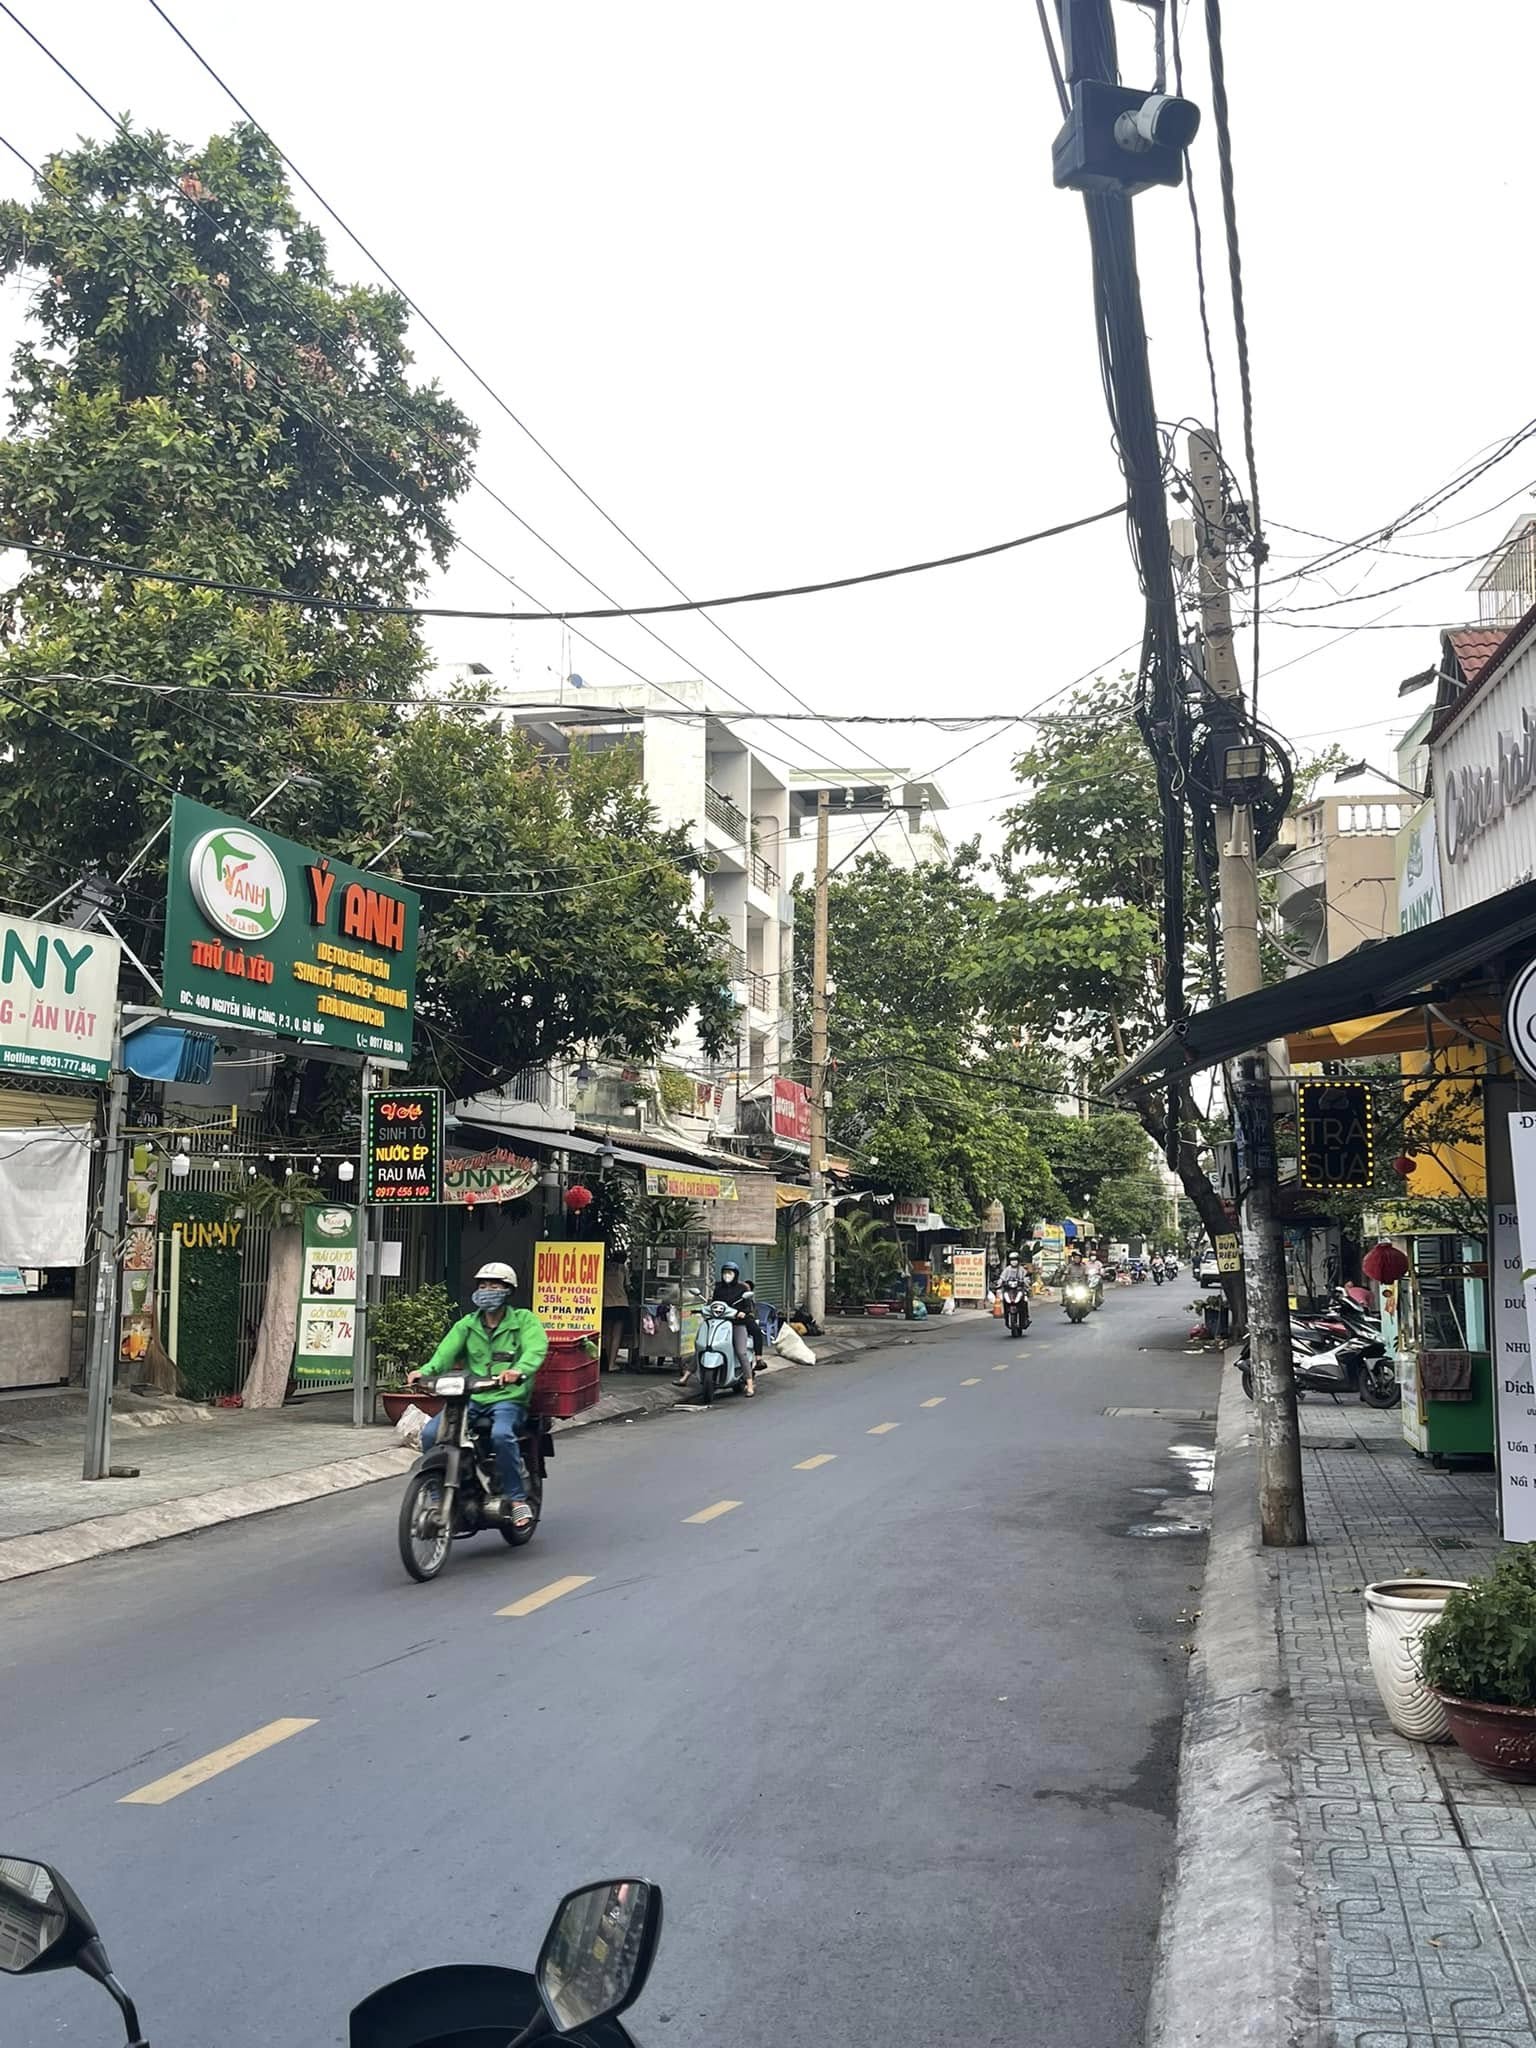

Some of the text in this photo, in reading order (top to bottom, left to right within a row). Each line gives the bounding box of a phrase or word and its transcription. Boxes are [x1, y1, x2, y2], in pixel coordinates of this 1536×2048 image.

[310, 858, 405, 952] Ý ANH
[1, 929, 94, 995] NY
[224, 947, 246, 977] LÀ
[247, 954, 274, 984] YÊU
[32, 999, 59, 1031] ĂN
[65, 1006, 96, 1040] VẶT
[3, 1050, 96, 1075] Hotline: 0931.777.846
[379, 1127, 406, 1140] SINH
[376, 1144, 410, 1162] NƯỚC
[412, 1143, 429, 1161] ÉP
[378, 1163, 426, 1182] RAU MÁ
[445, 1168, 521, 1188] UNNY
[336, 1265, 355, 1282] 20k
[538, 1247, 600, 1285] BÚN CÁ CAY
[538, 1305, 550, 1314] CF
[552, 1305, 572, 1314] PHA
[337, 1321, 352, 1339] 7k
[1505, 1342, 1530, 1353] NHU
[1505, 1380, 1534, 1396] Dịch
